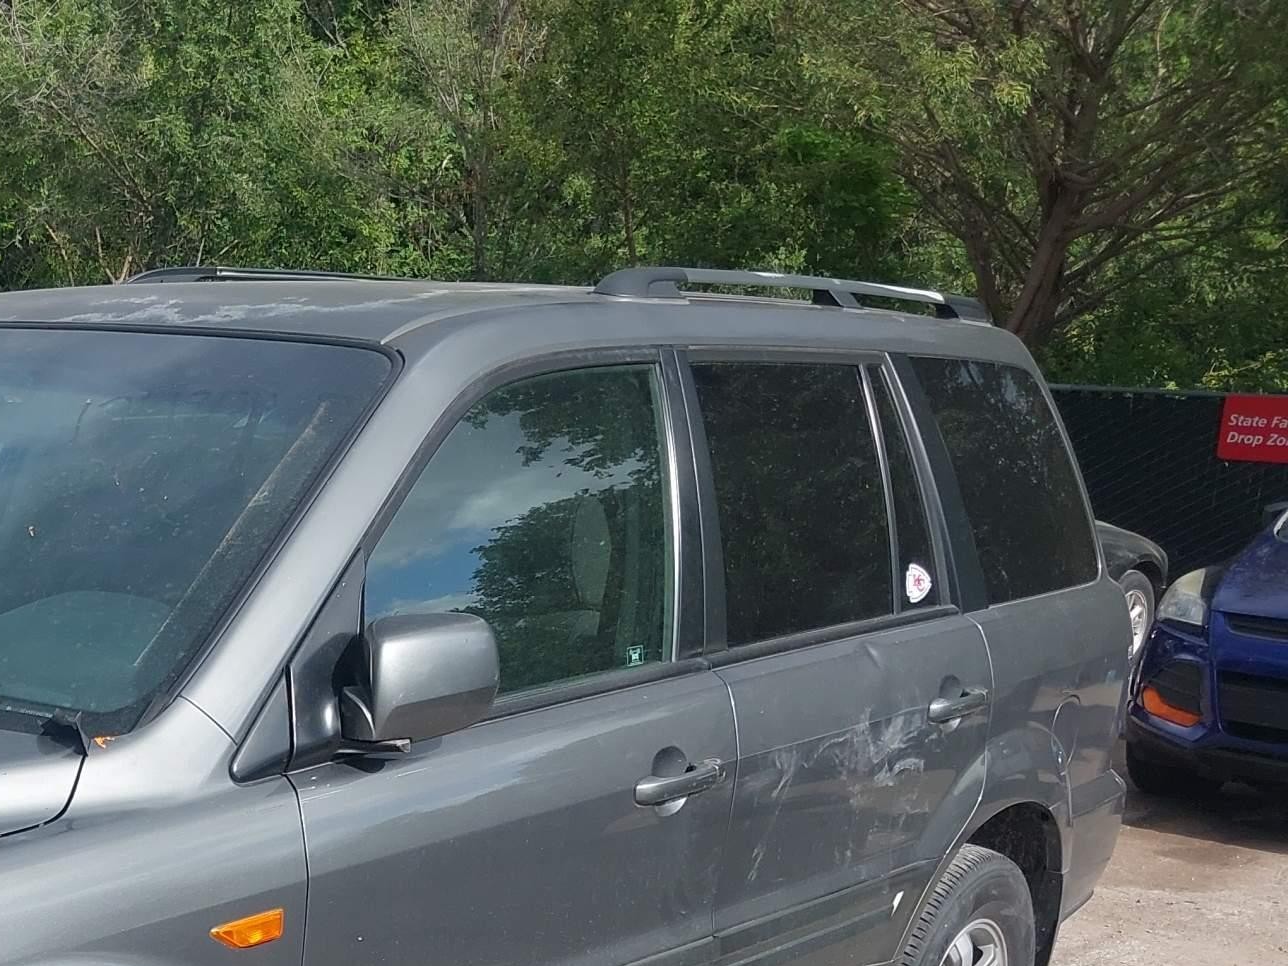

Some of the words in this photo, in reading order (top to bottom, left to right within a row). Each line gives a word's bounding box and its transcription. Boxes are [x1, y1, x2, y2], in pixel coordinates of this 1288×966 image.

[1228, 414, 1267, 427] State
[1227, 431, 1263, 447] Drop
[1266, 434, 1288, 446] Zo
